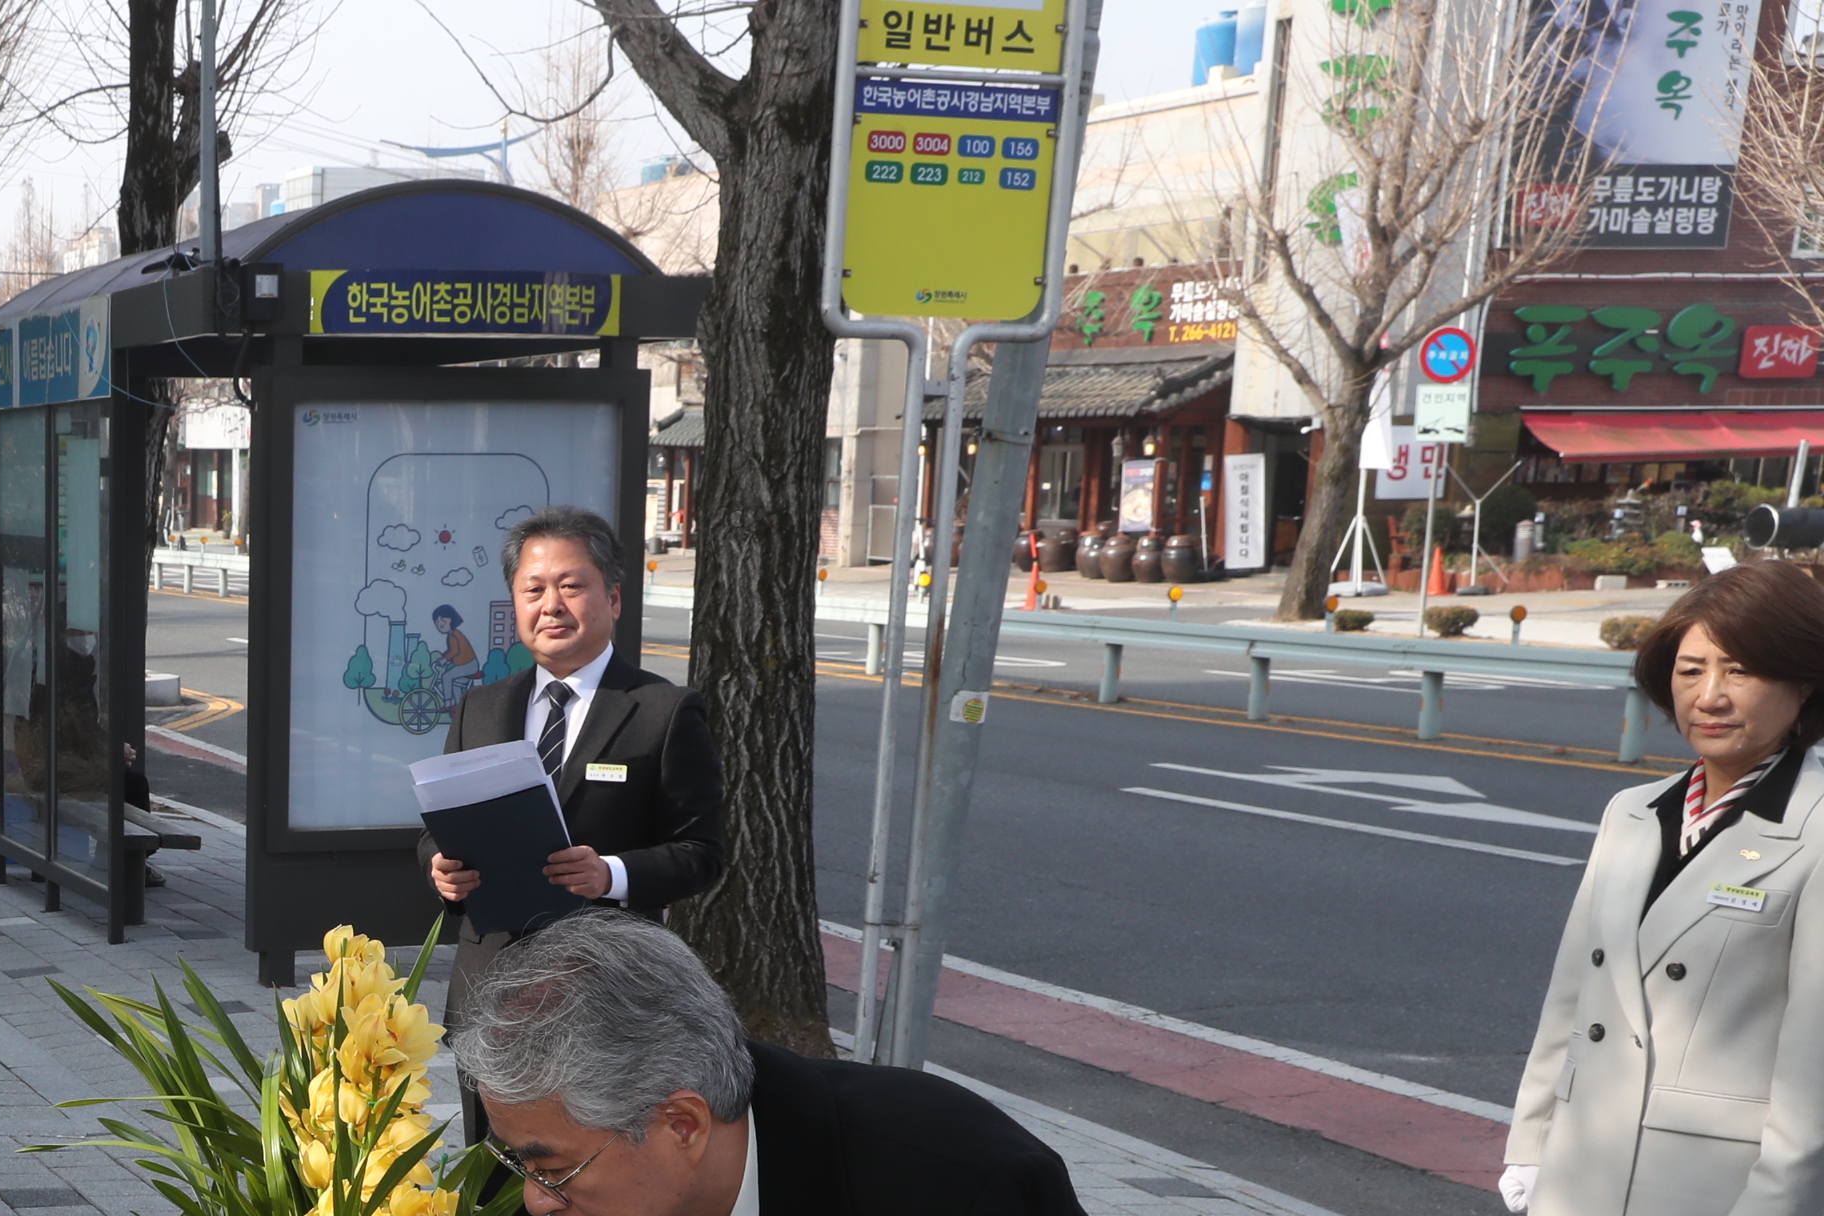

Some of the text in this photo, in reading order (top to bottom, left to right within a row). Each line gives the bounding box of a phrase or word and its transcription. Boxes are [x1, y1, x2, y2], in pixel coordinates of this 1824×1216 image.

[883, 10, 1035, 55] 일반버스
[862, 84, 1051, 116] 한국농어촌공사경남지역본부
[870, 135, 1033, 157] 3000 3004 100 156
[872, 165, 1030, 187] 222 223 212 152
[1592, 176, 1723, 204] 무릎도가니탕
[1587, 207, 1718, 235] 가마솥설렁탕
[347, 281, 596, 326] 한국농어촌공사경남지역본부
[1181, 322, 1237, 341] 266-4121
